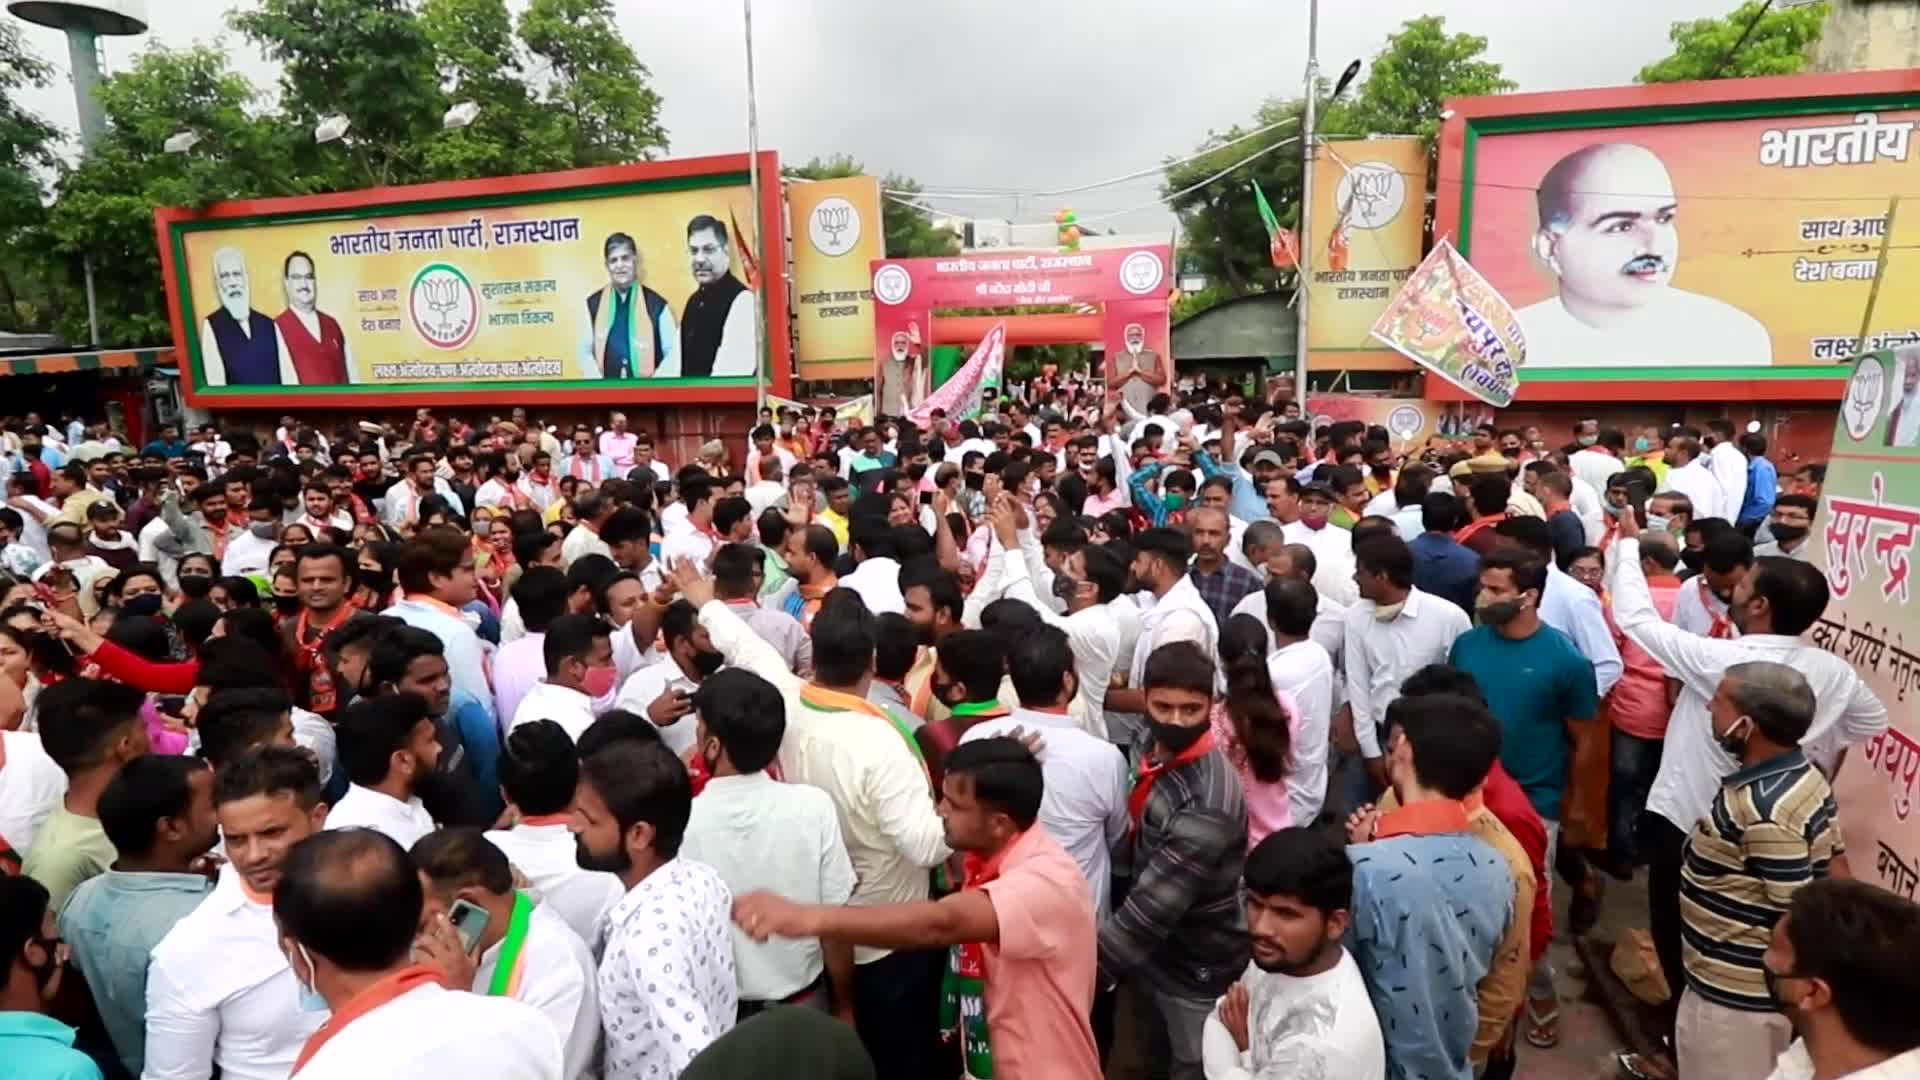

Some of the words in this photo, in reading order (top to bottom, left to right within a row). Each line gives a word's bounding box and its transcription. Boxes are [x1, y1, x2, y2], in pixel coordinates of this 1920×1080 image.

[1760, 112, 1914, 168] भारतीय
[330, 226, 391, 255] भारतीय
[395, 228, 443, 250] जनता
[449, 219, 489, 250] पार्टी,
[493, 218, 579, 245] राजस्थान
[1801, 220, 1845, 239] साथ
[1794, 256, 1828, 281] देश
[1337, 287, 1390, 300] राजस्थान
